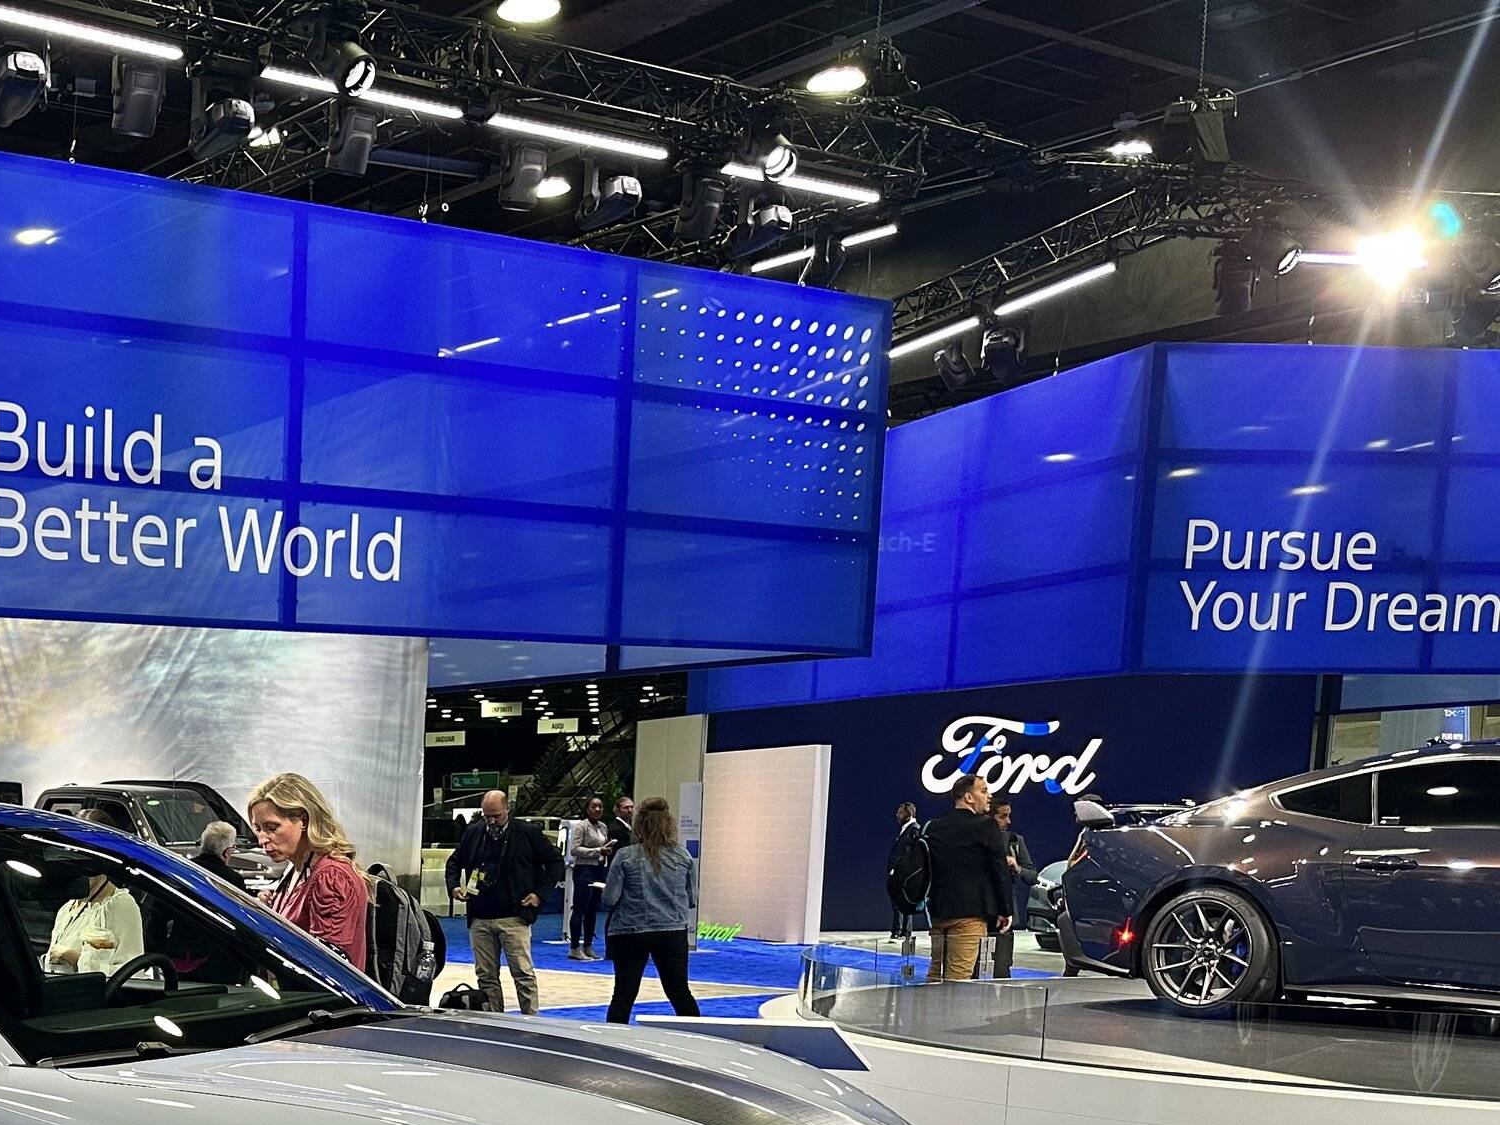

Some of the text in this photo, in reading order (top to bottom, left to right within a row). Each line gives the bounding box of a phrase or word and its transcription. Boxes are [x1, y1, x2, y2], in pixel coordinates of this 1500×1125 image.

[189, 436, 222, 491] a
[218, 505, 402, 582] World
[1184, 518, 1377, 571] Pursue
[1179, 580, 1307, 632] Your
[921, 715, 1103, 795] Ford
